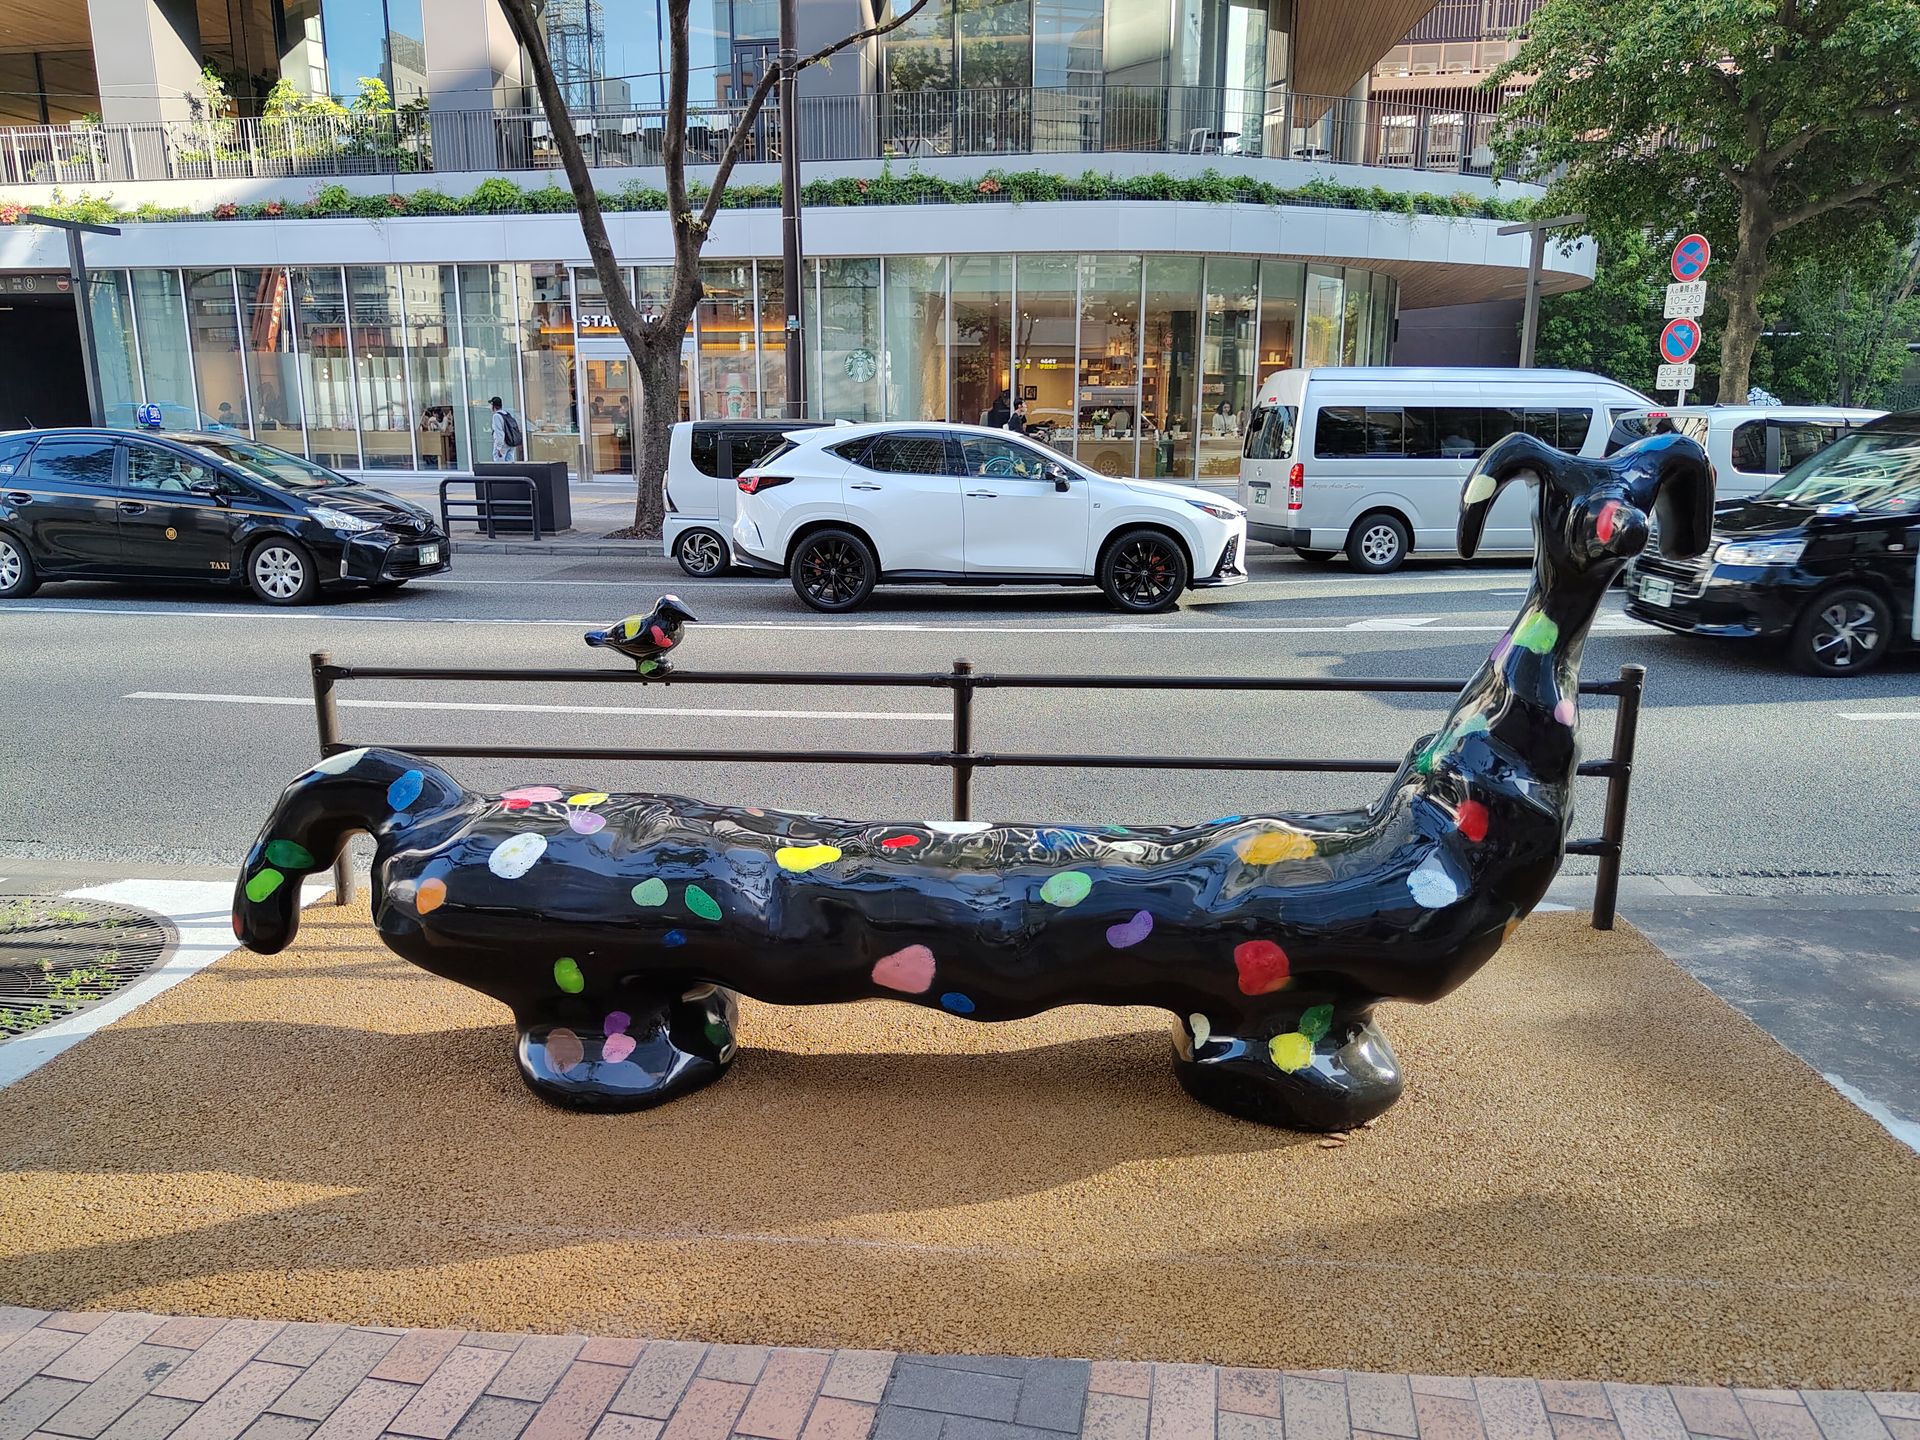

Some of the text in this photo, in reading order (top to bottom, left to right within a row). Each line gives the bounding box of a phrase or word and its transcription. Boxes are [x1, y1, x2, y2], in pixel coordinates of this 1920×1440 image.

[1670, 294, 1701, 305] 10-20
[1669, 305, 1699, 315] ここまで
[1660, 379, 1689, 387] ここまで
[209, 561, 230, 570] TAXI
